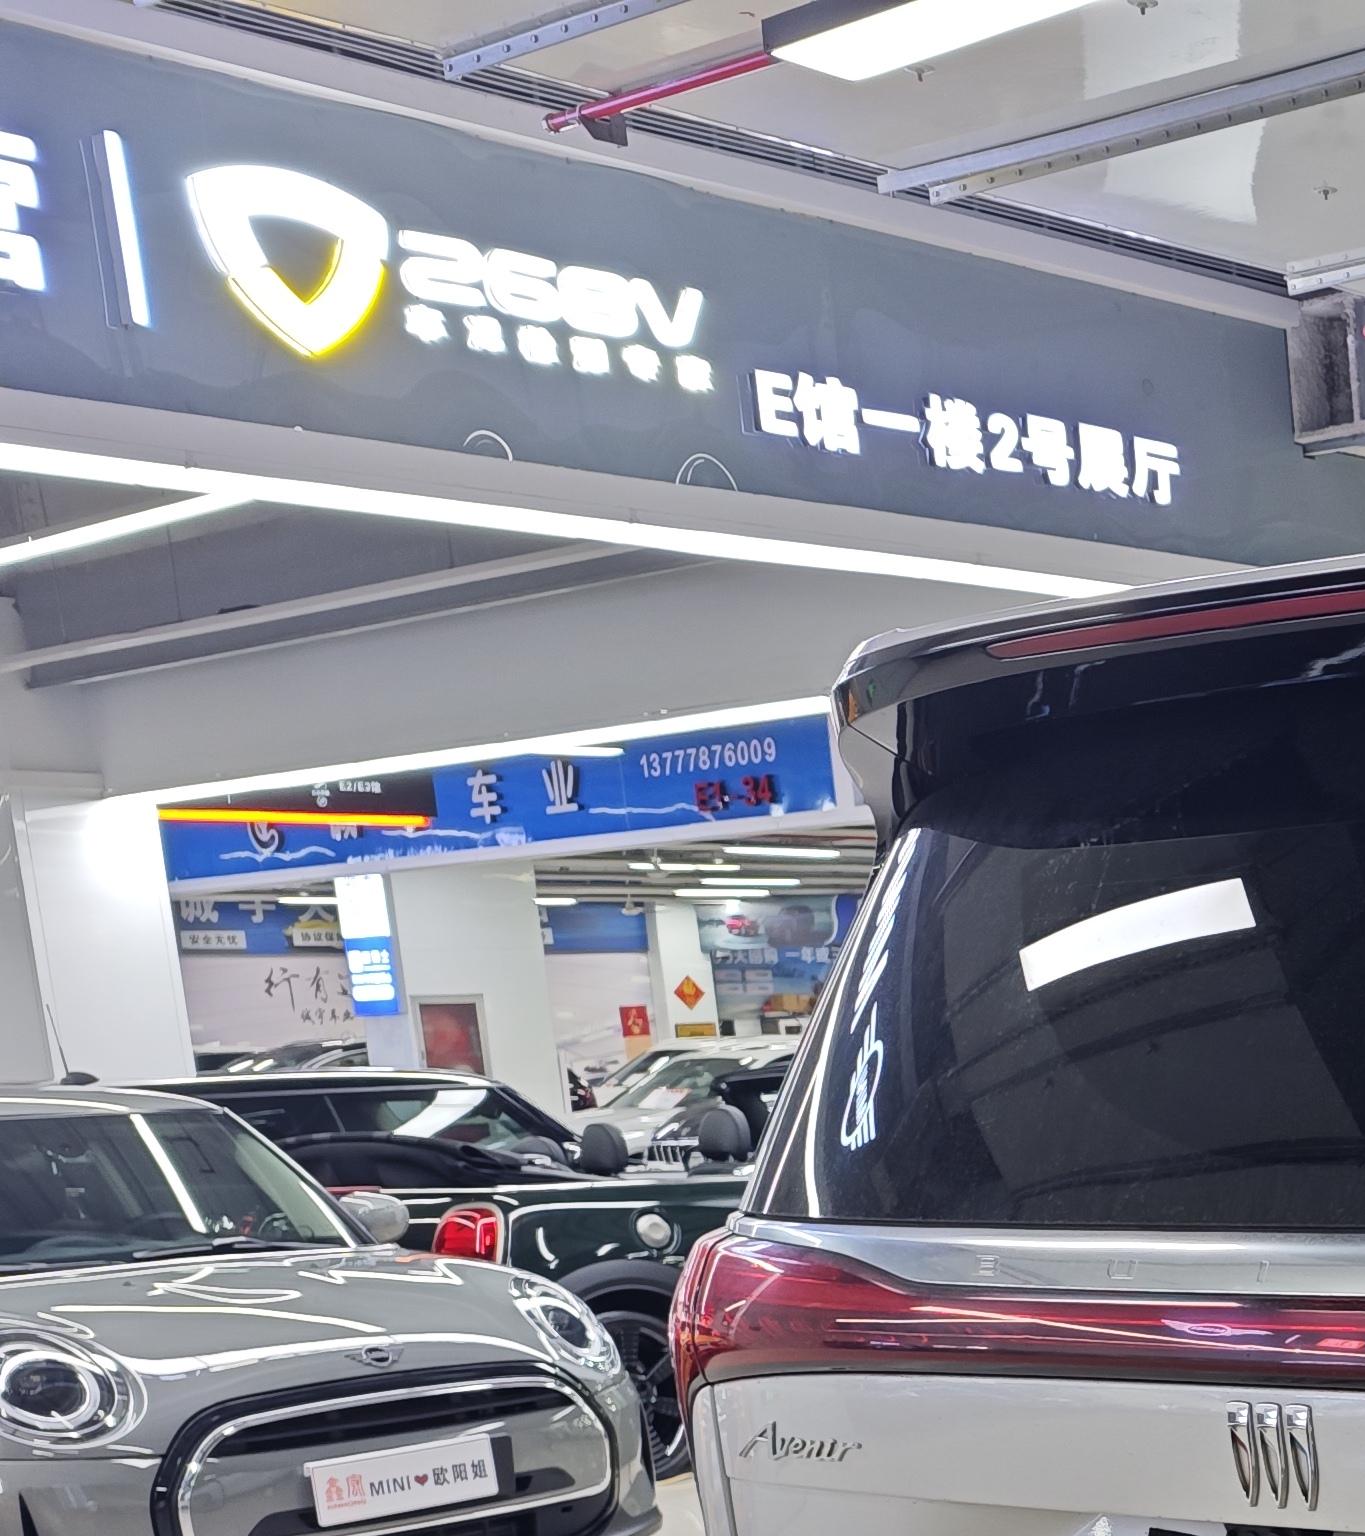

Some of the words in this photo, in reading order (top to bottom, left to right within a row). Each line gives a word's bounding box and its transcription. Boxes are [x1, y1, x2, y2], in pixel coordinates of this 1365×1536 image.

[639, 737, 777, 779] 13777876009
[738, 1420, 863, 1462] Avenir
[369, 1475, 412, 1497] MINI
[432, 1459, 489, 1486] 欧阳姐
